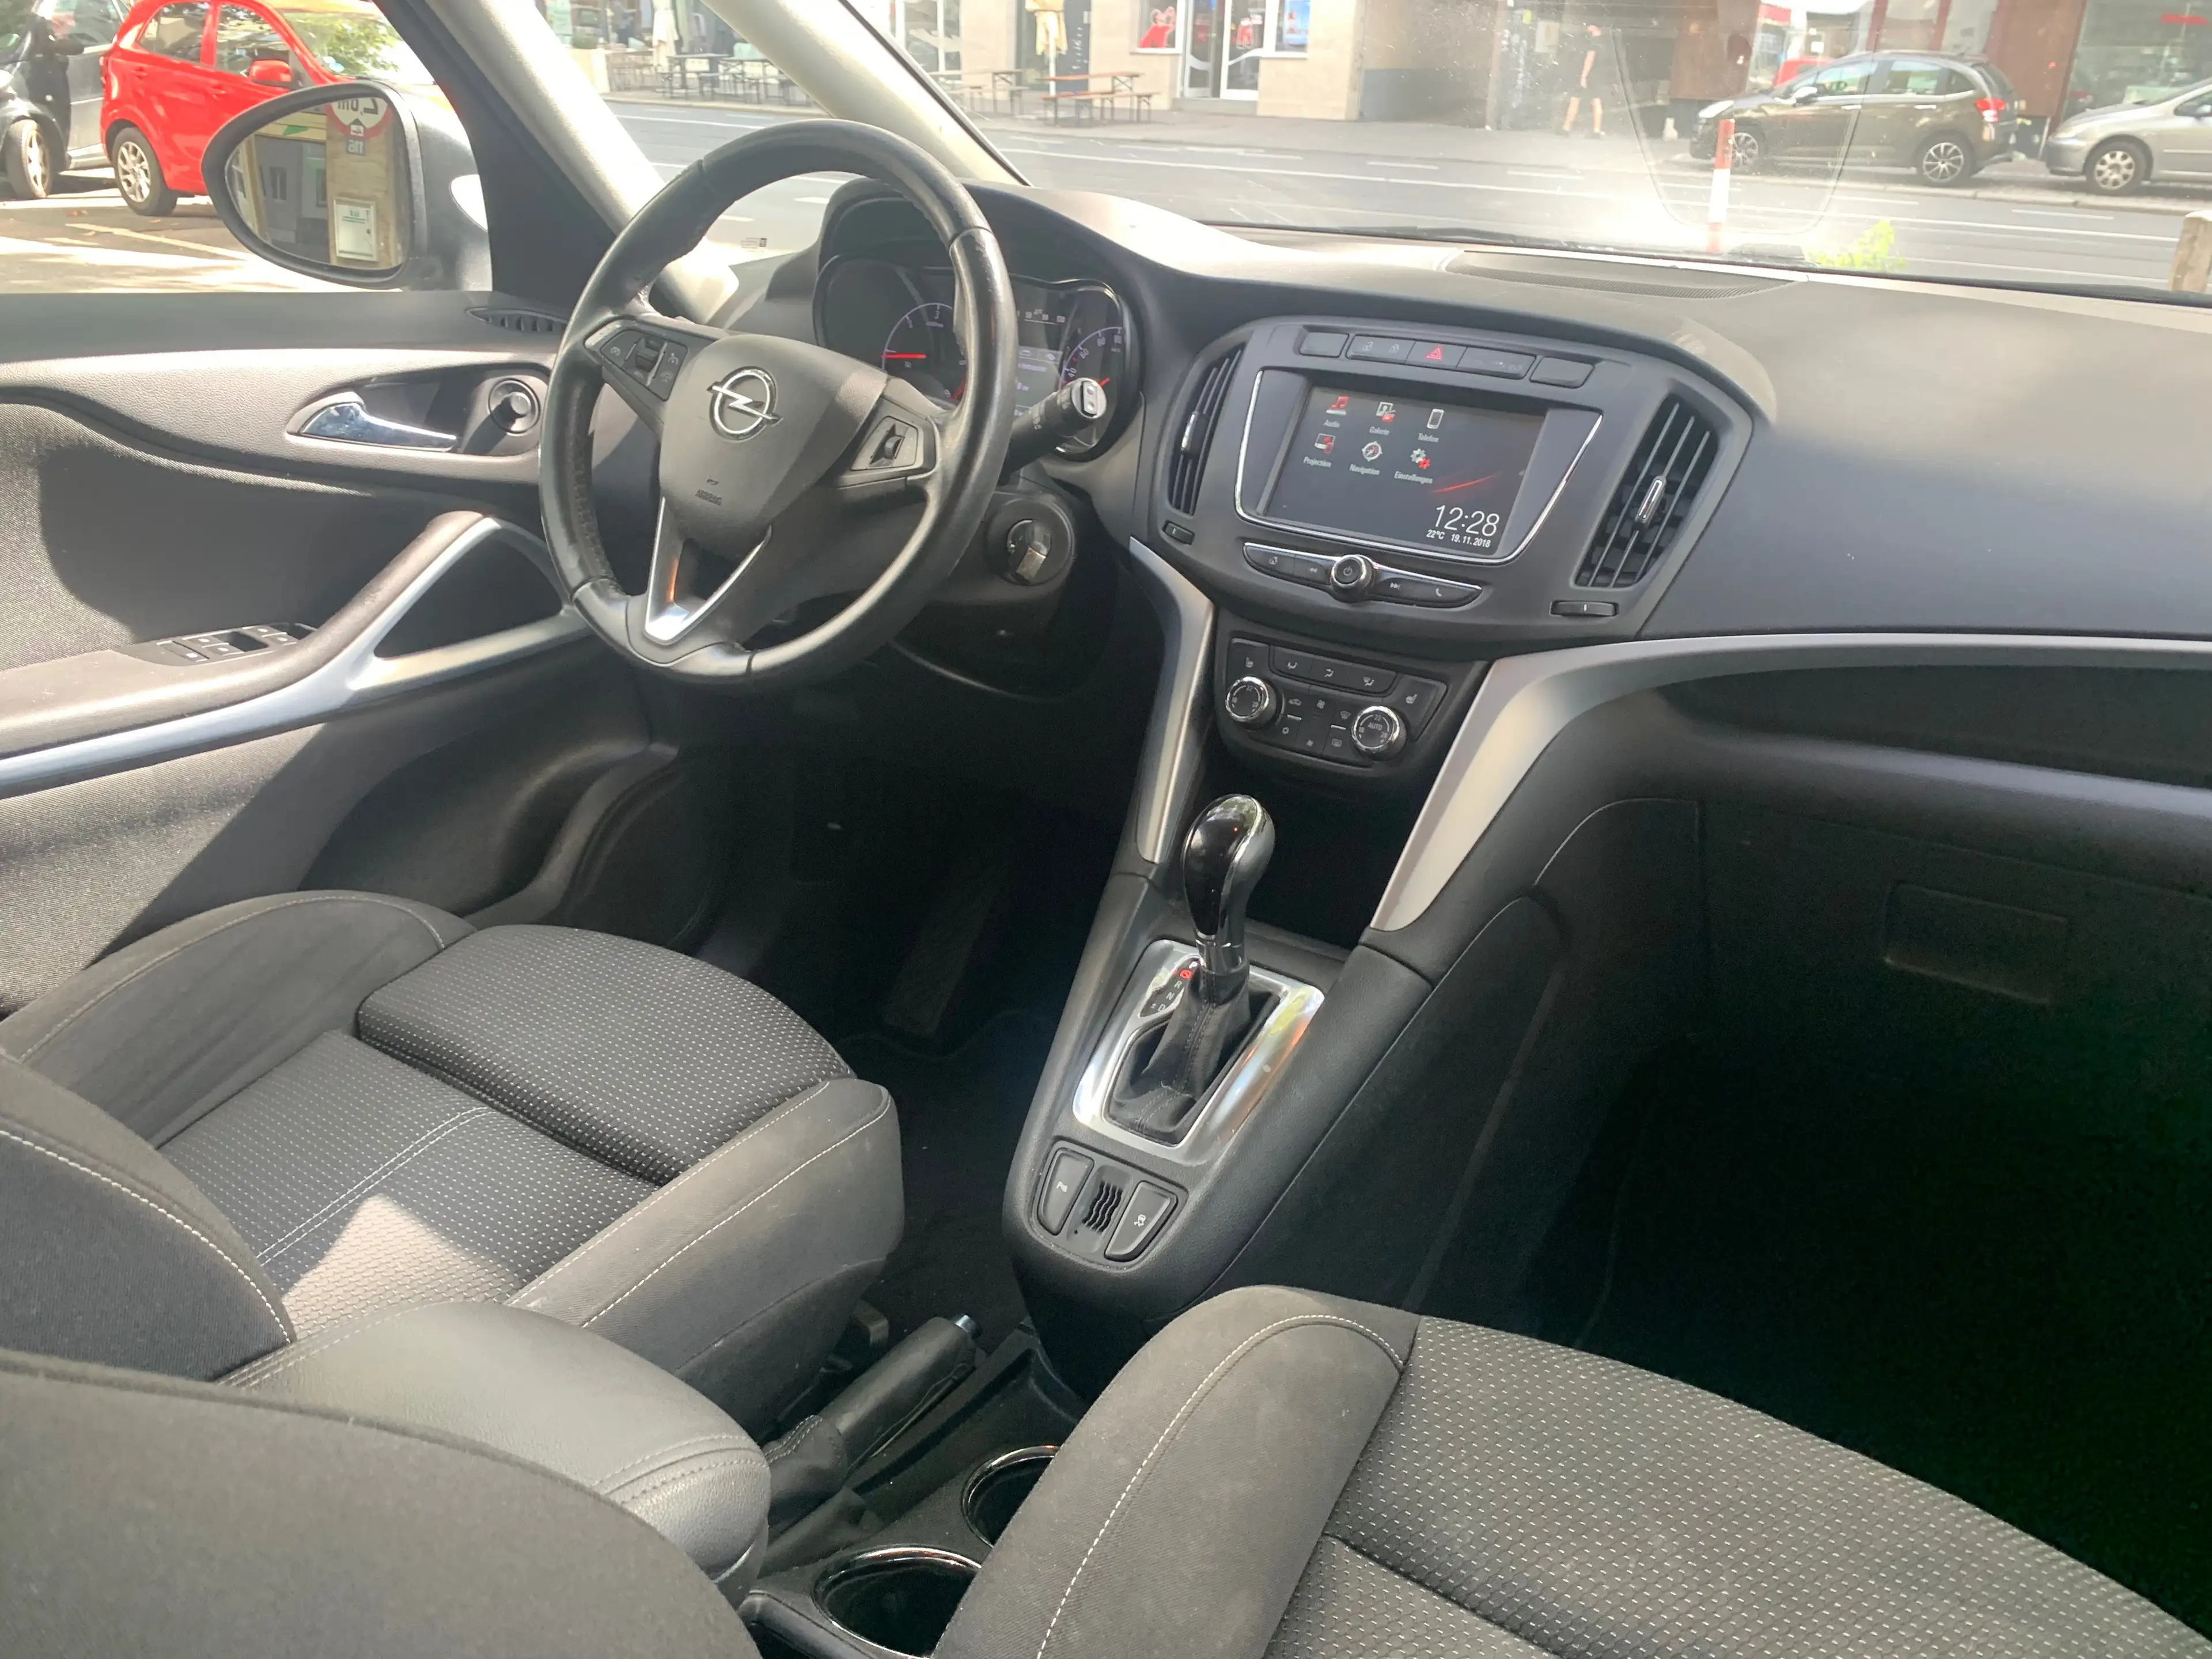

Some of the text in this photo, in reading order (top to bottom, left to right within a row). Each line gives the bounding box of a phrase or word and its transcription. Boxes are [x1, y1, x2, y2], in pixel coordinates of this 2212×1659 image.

[1418, 433, 1439, 443] Telefon
[1303, 456, 1332, 468] Projection
[1349, 464, 1380, 475] Navigation
[1394, 471, 1433, 484] Einstellungen
[1435, 505, 1500, 537] 12:28
[1426, 529, 1445, 540] 22°C
[1368, 722, 1383, 731] AUTO
[1174, 980, 1183, 988] R
[1165, 992, 1175, 1001] N
[1157, 1003, 1166, 1012] D
